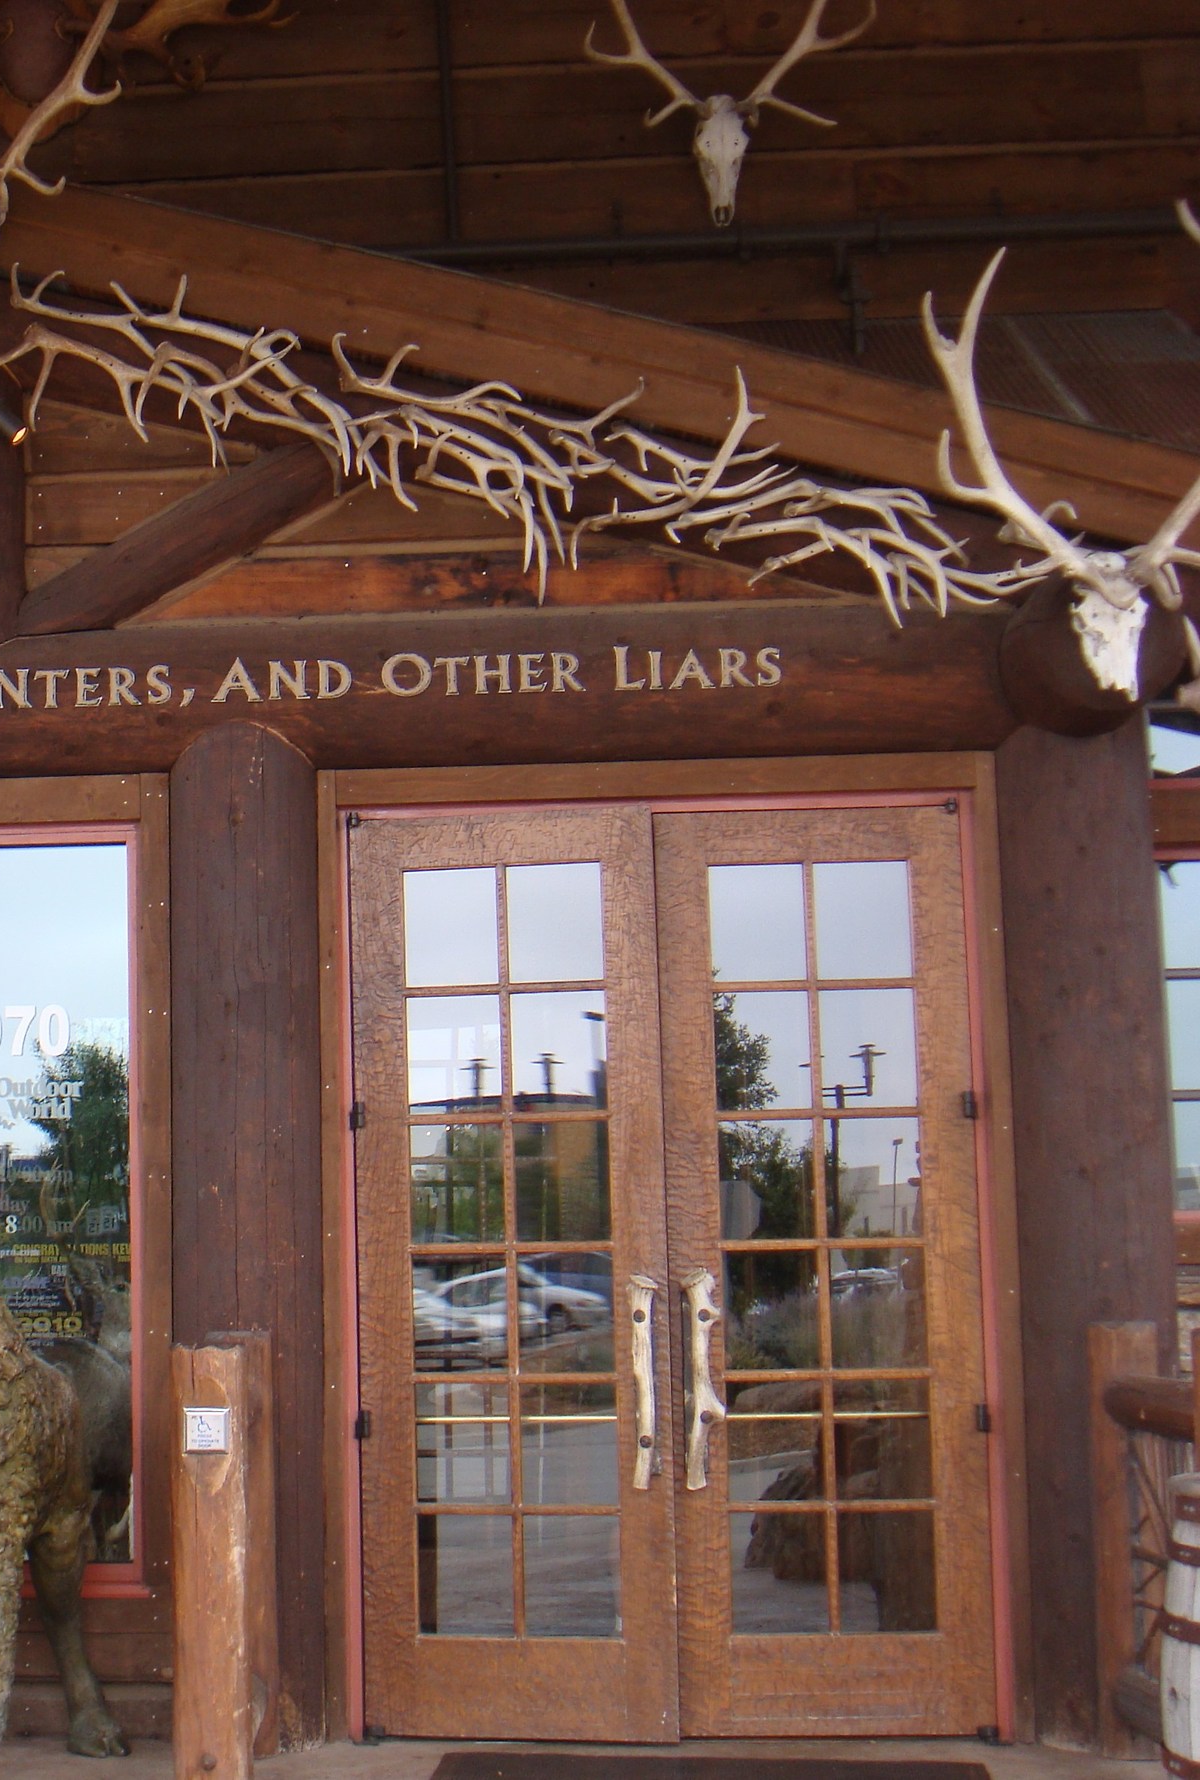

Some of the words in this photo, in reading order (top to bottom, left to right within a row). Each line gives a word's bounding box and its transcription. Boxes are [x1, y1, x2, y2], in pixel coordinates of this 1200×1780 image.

[211, 656, 353, 704] AND
[380, 652, 586, 698] OTHER
[612, 645, 783, 692] LIARS
[7, 1097, 73, 1121] World
